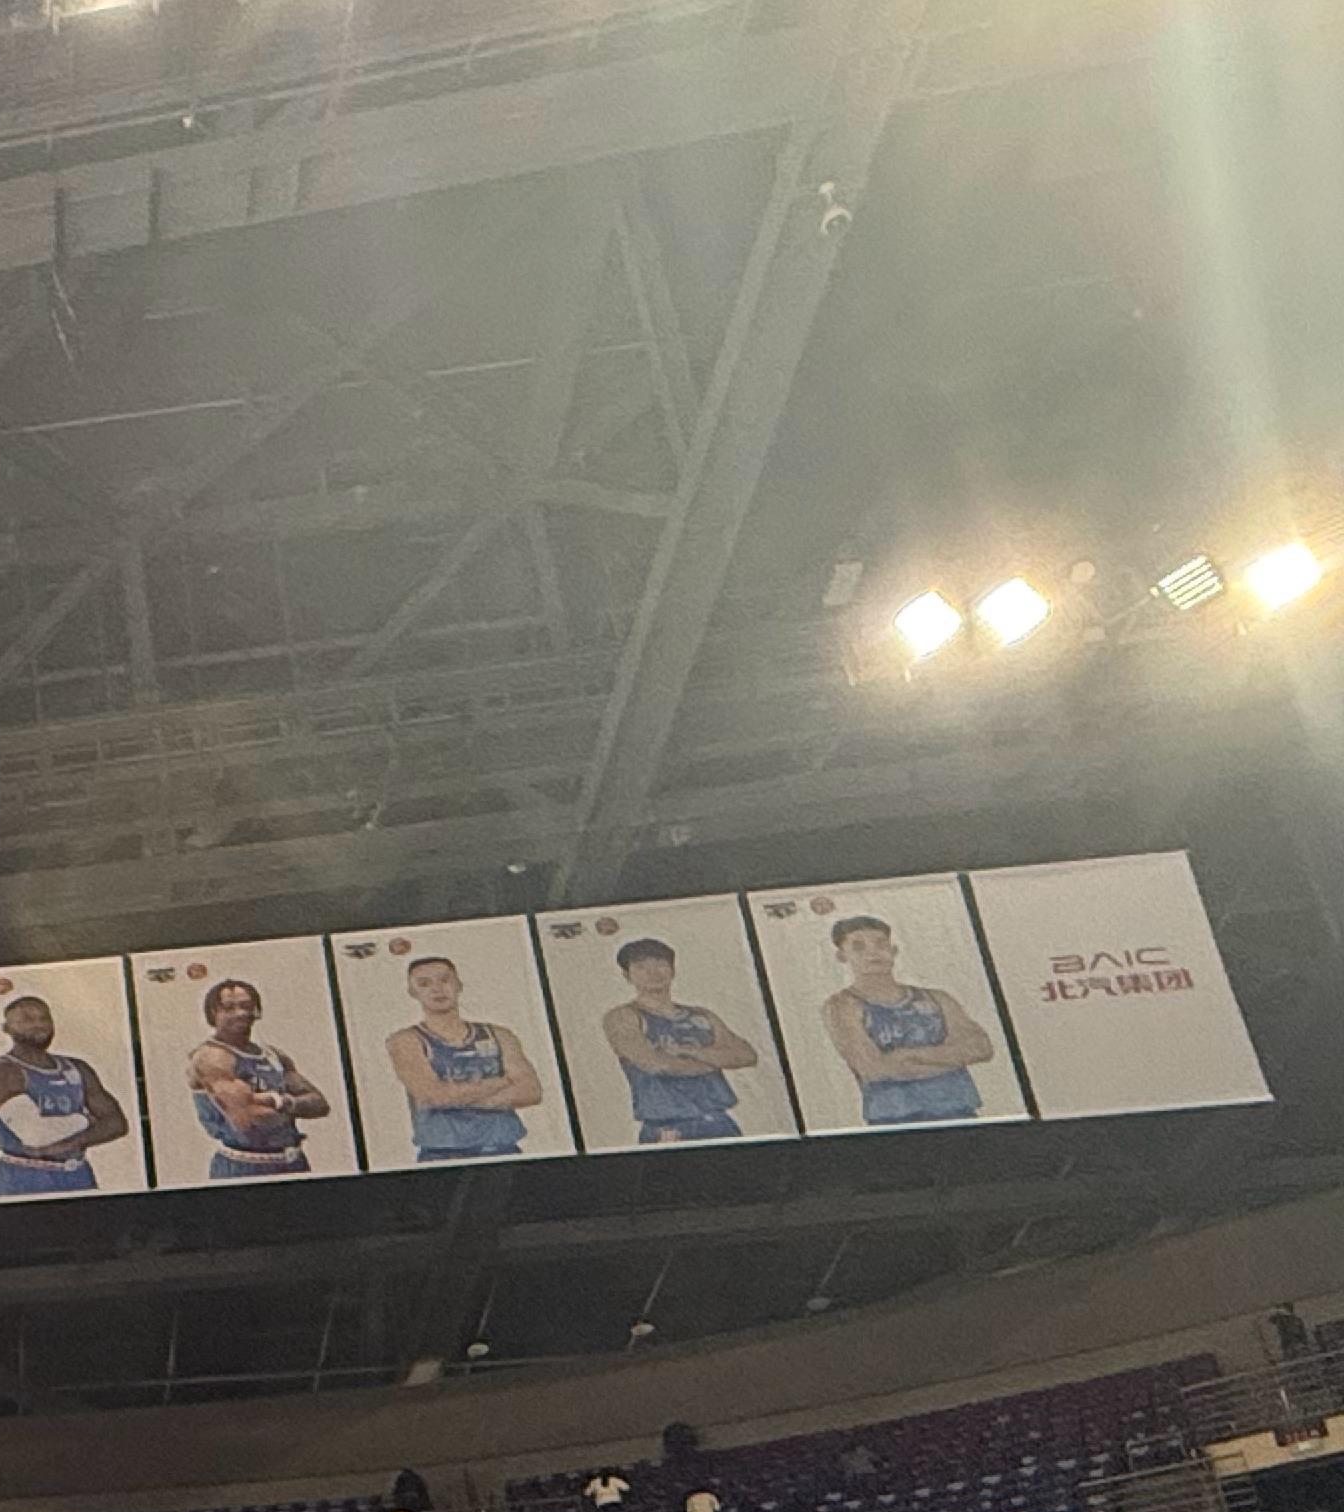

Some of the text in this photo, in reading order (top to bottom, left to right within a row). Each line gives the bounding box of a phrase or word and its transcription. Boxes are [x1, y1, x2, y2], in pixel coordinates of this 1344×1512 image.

[1048, 946, 1172, 974] BAIC
[1040, 967, 1194, 1002] 北汽集团
